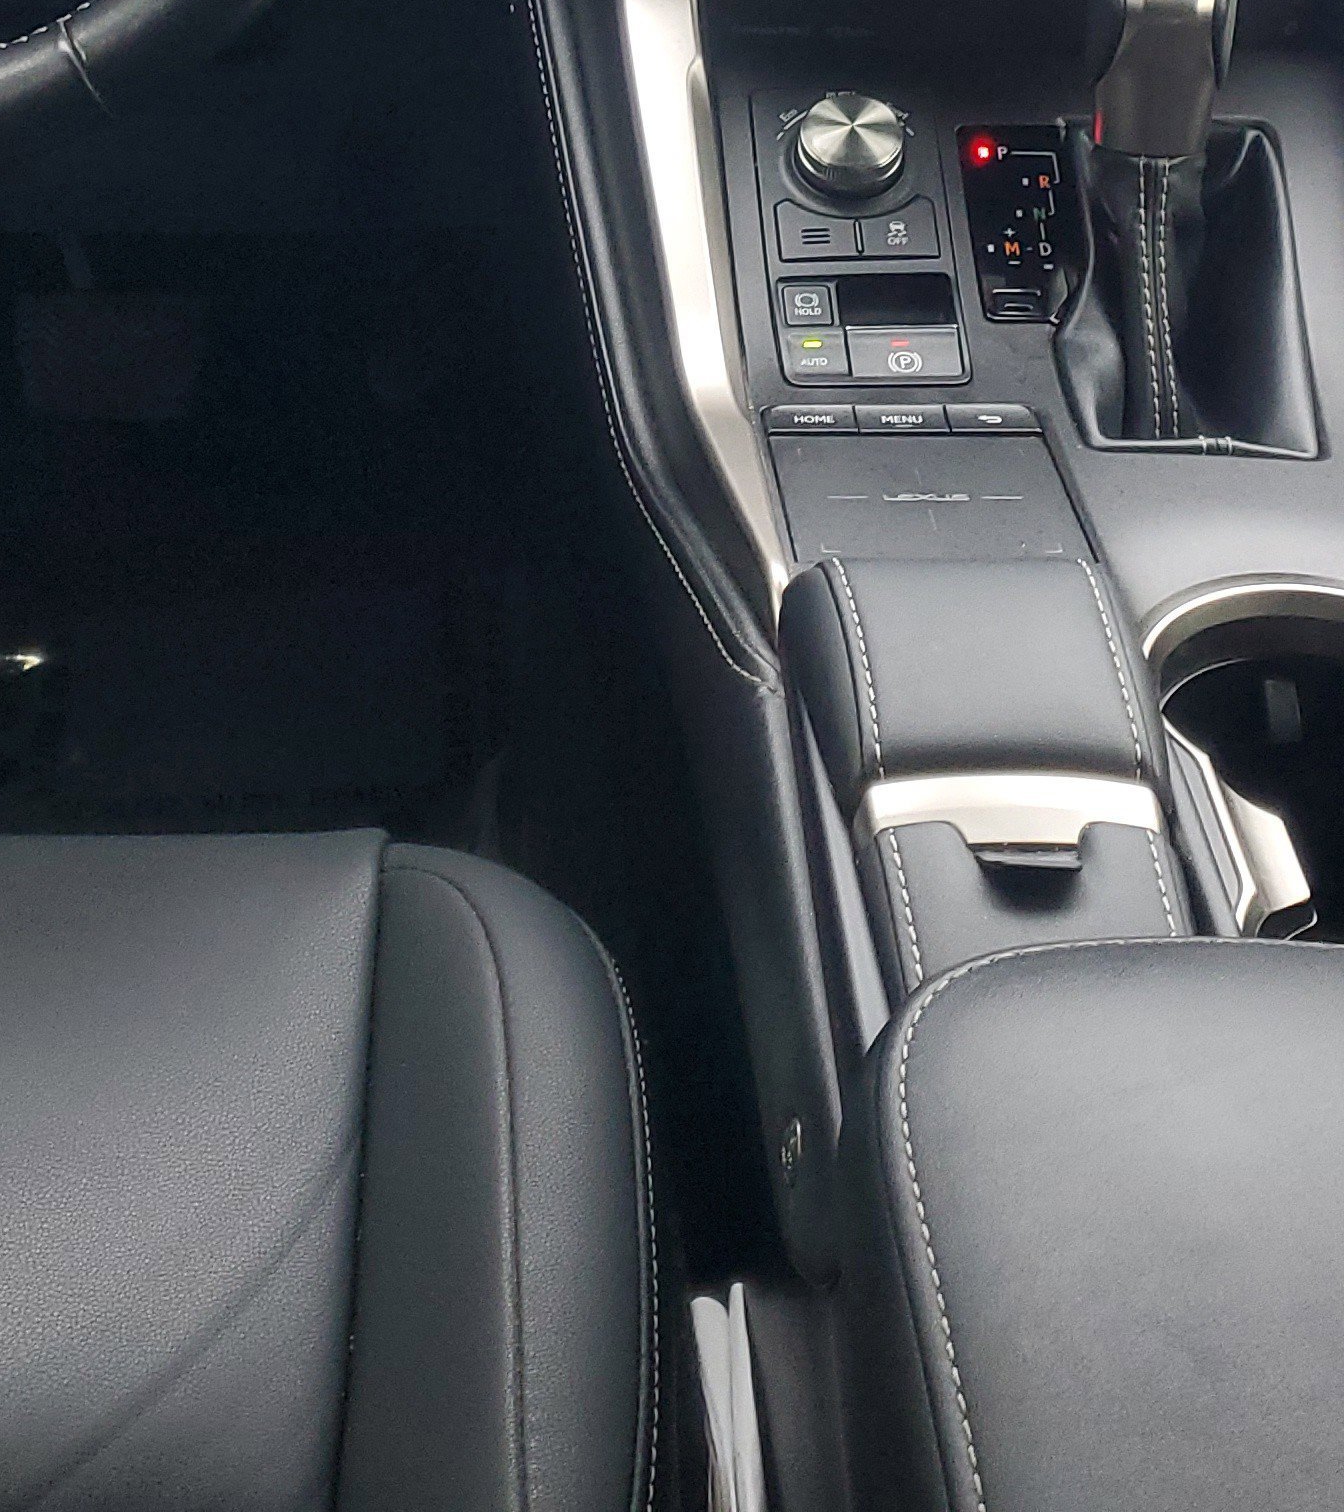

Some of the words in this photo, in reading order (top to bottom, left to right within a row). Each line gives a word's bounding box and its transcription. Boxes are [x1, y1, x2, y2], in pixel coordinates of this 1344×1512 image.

[996, 146, 1009, 160] P
[1038, 174, 1051, 188] R
[1033, 206, 1047, 221] N
[1005, 241, 1021, 257] M
[1038, 241, 1053, 257] D
[794, 306, 822, 317] HOLD
[801, 356, 828, 368] AUTO
[793, 415, 836, 425] HOME
[881, 414, 923, 425] MENU
[882, 493, 971, 502] LEXUS
